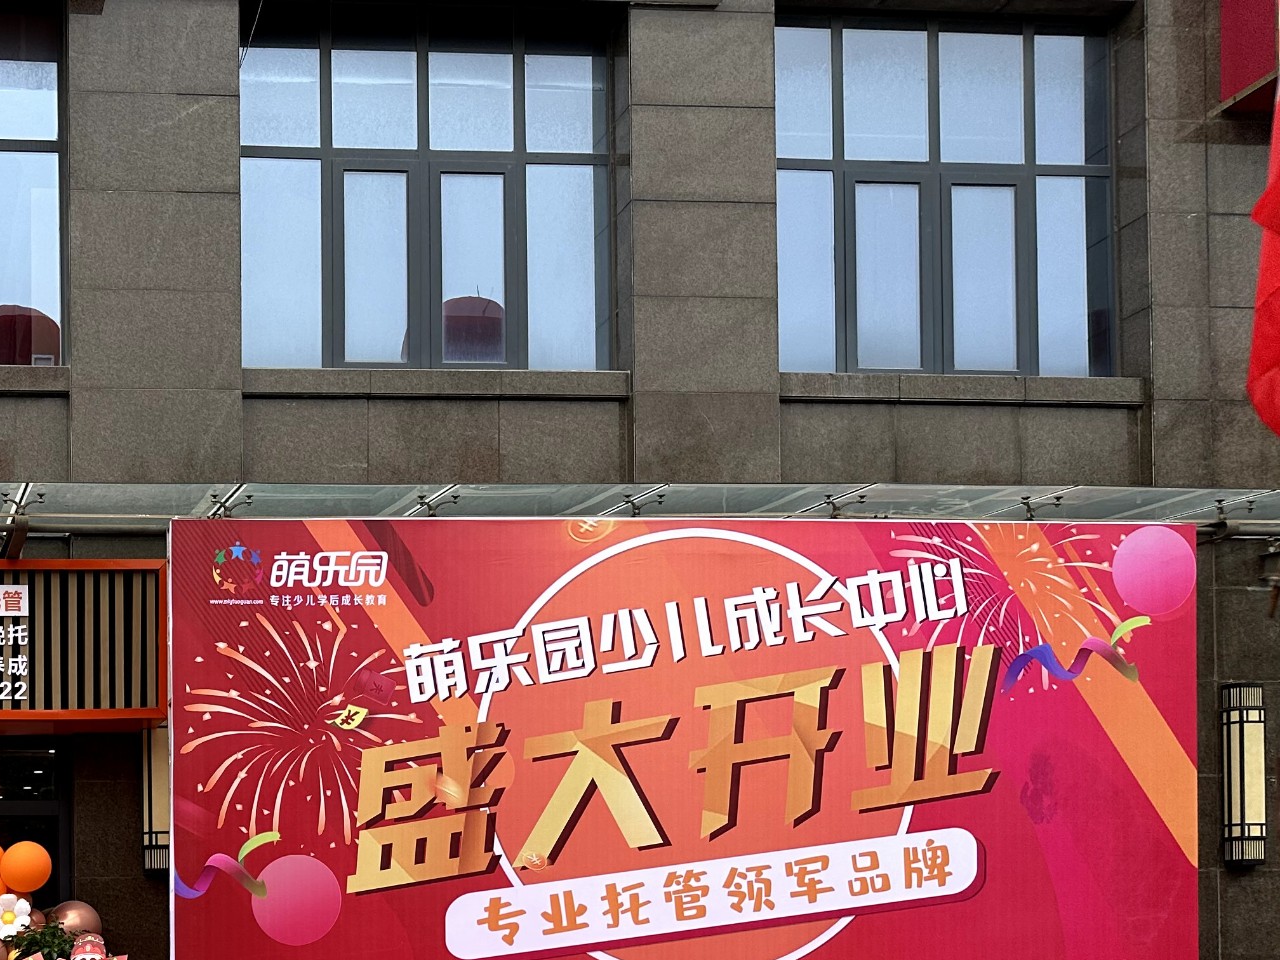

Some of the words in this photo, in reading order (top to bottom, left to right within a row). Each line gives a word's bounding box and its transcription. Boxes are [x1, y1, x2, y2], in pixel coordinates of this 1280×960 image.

[269, 594, 388, 607] 专注少儿学后成长教育
[270, 551, 389, 588] 萌乐园
[404, 557, 968, 703] 萌乐园少儿成长中心
[346, 644, 1002, 895] 盛大开业
[477, 838, 956, 948] 专业托管领军品牌
